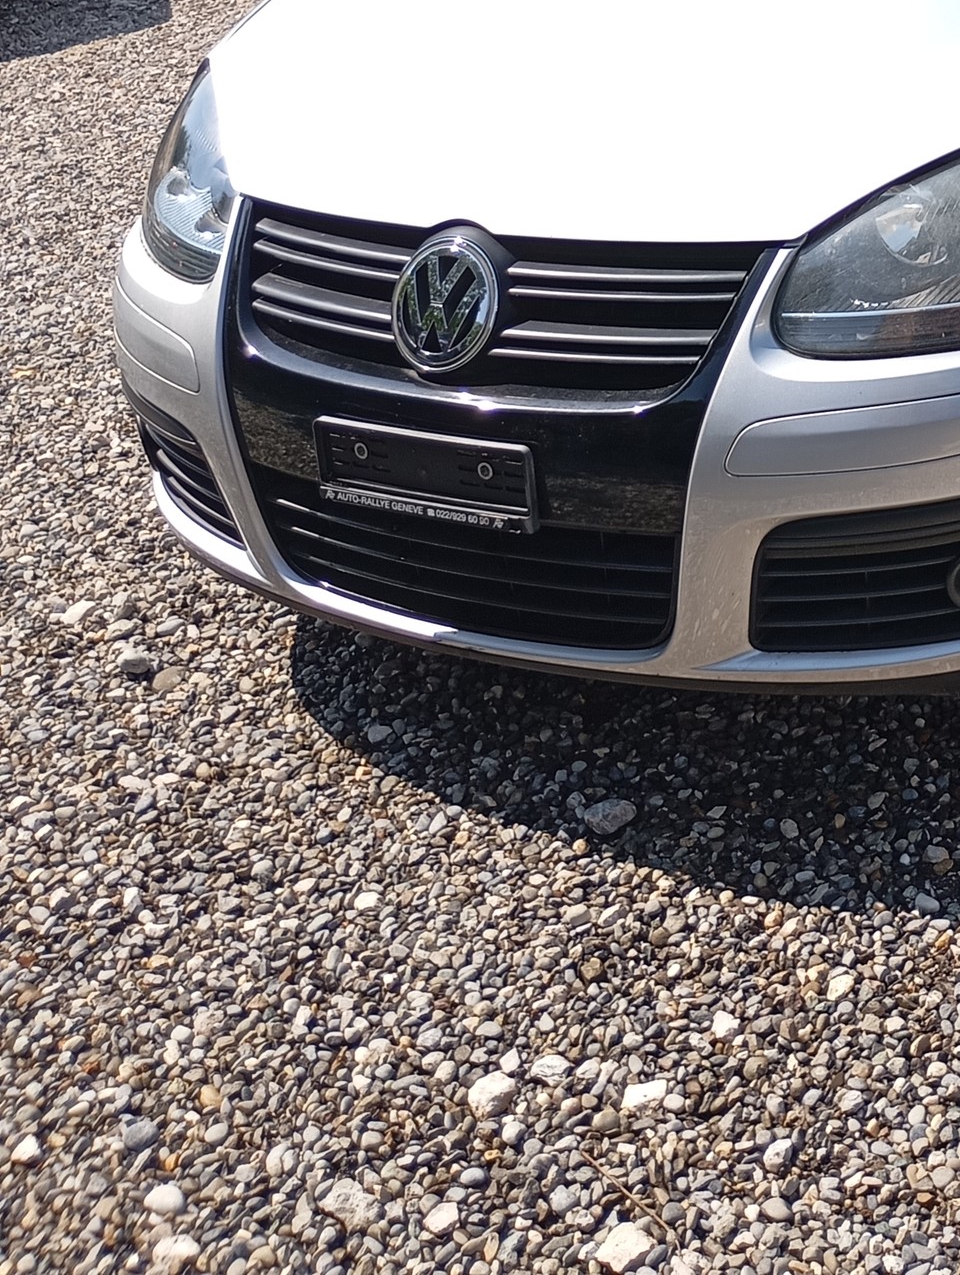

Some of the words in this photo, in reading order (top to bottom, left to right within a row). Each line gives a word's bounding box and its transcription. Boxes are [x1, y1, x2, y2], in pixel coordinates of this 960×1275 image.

[336, 492, 390, 510] AUTO-RALLYE
[391, 501, 425, 516] GENEVE
[435, 509, 467, 523] 022/929
